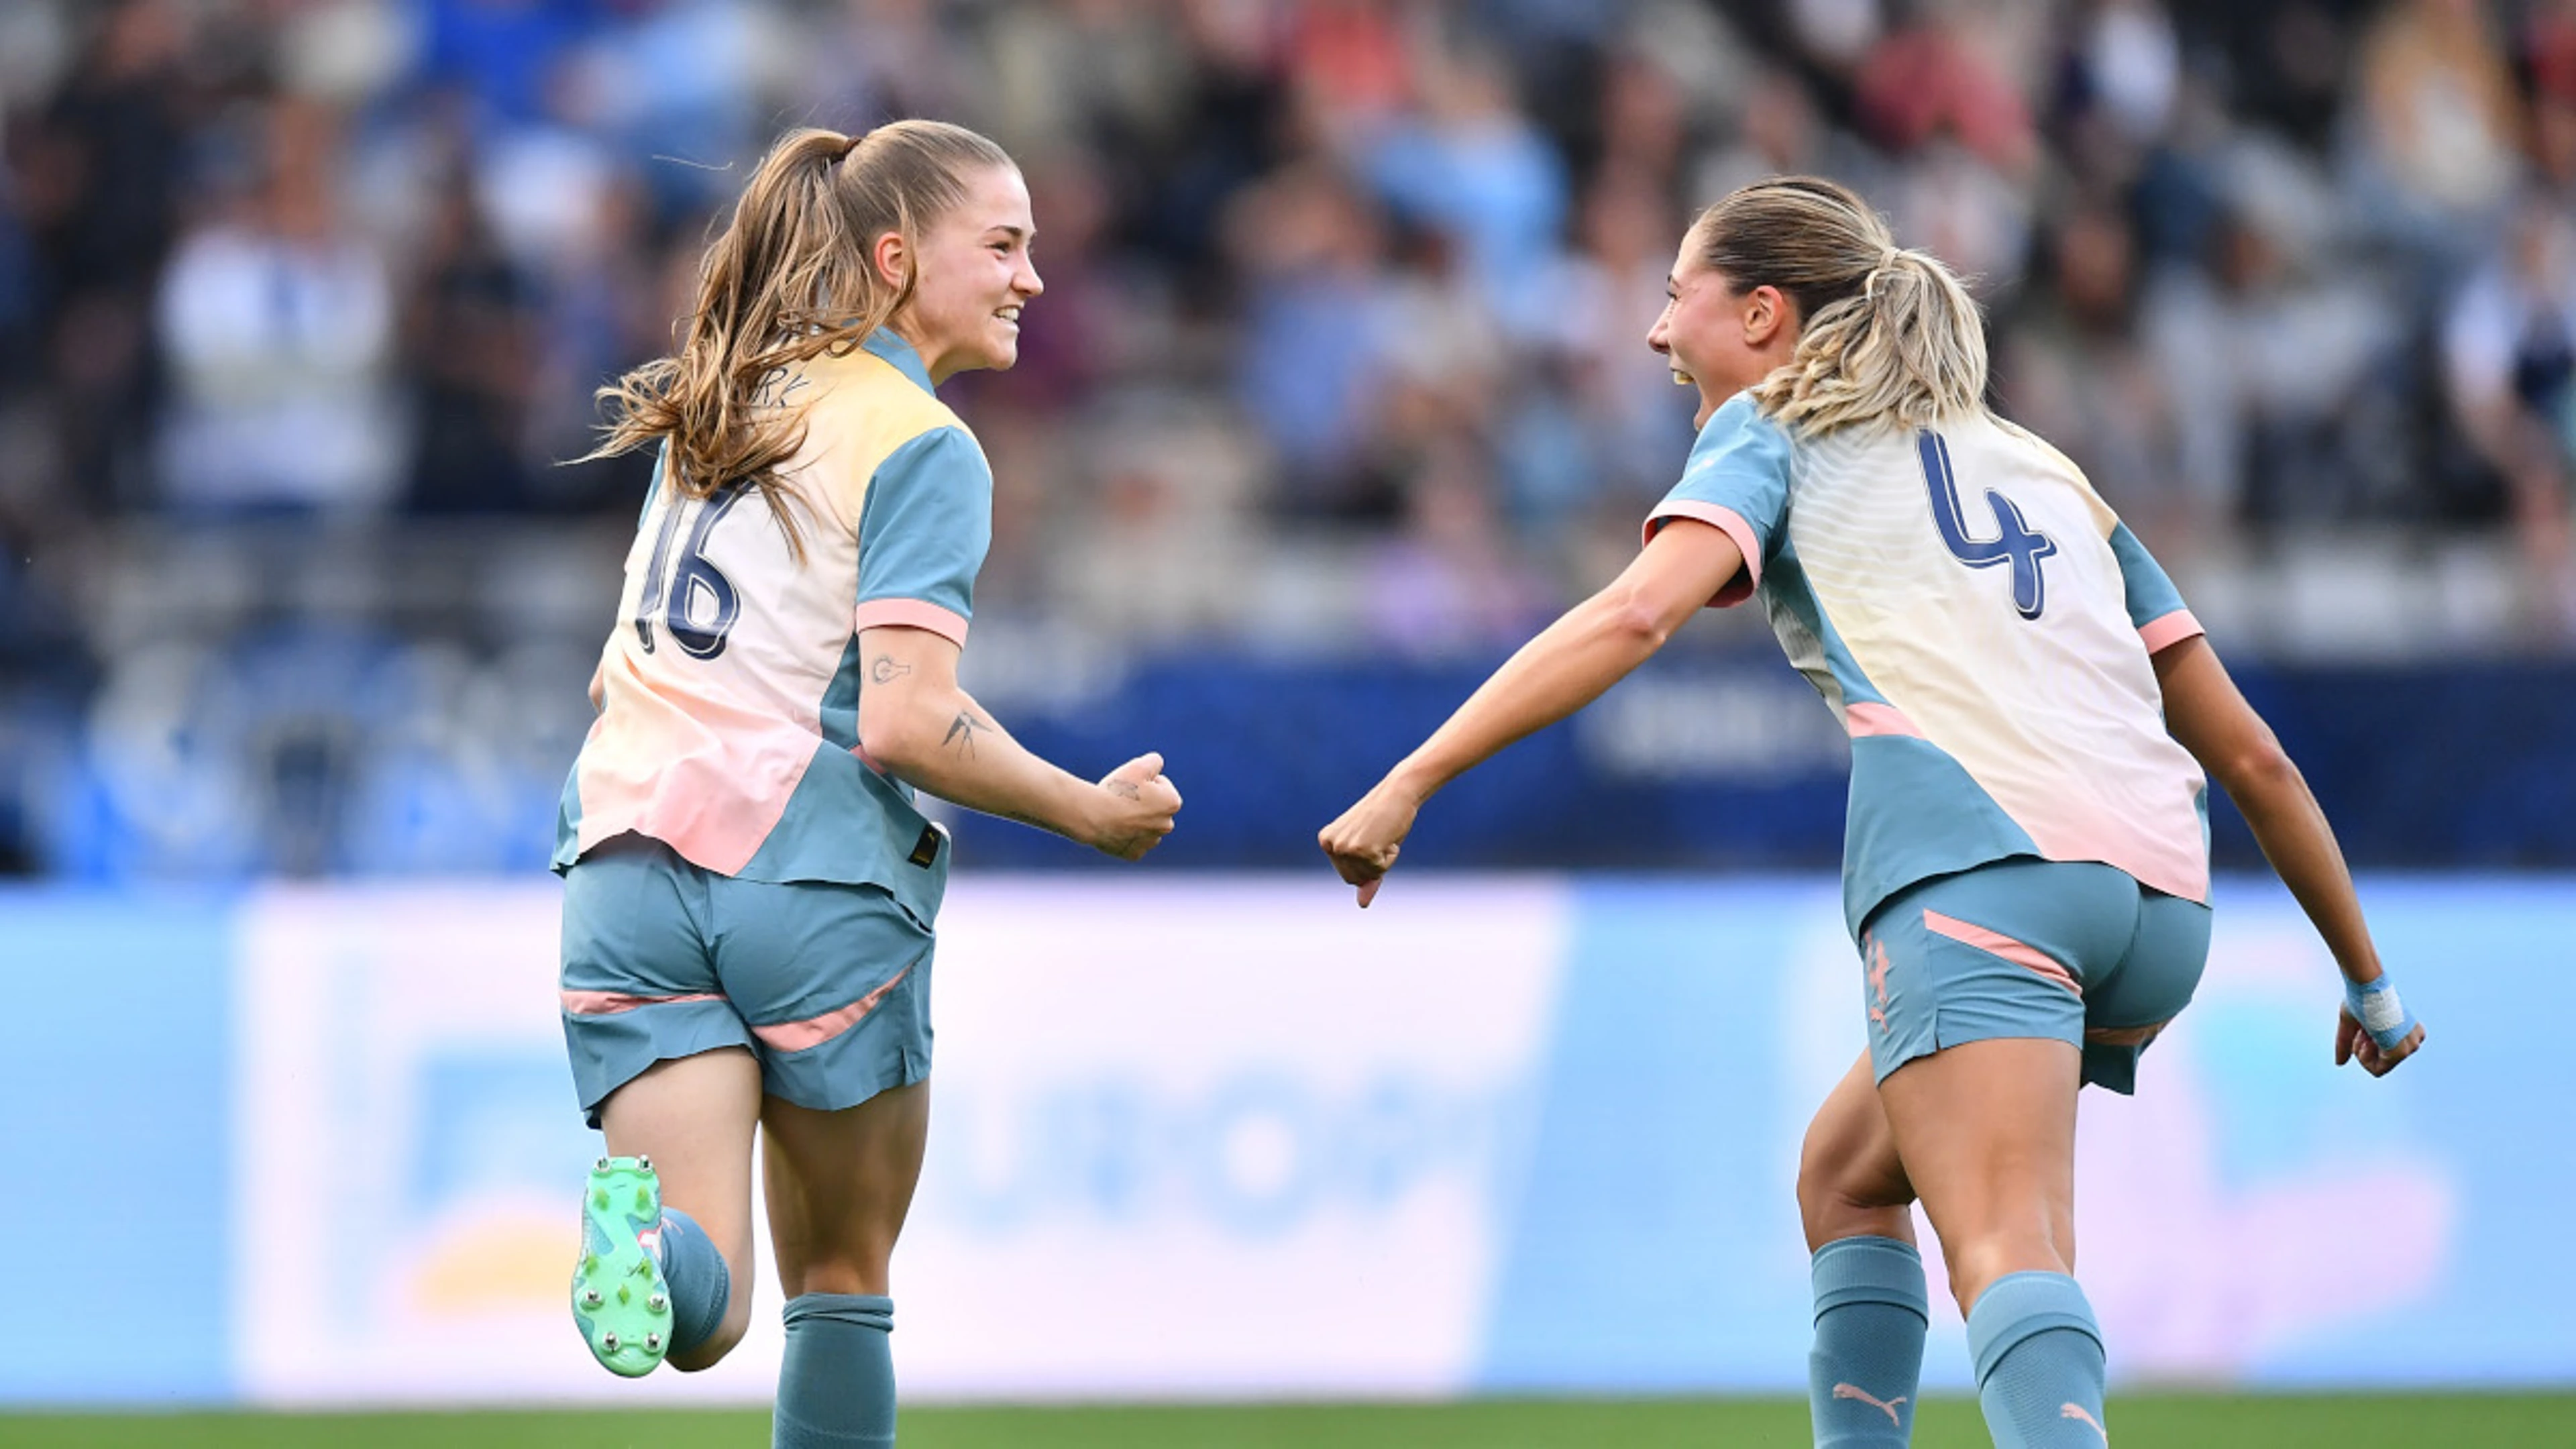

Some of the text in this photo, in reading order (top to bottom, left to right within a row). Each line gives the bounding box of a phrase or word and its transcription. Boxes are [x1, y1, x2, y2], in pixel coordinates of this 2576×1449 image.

[749, 366, 812, 407] RK
[635, 478, 756, 661] 16
[1915, 426, 2057, 621] 4
